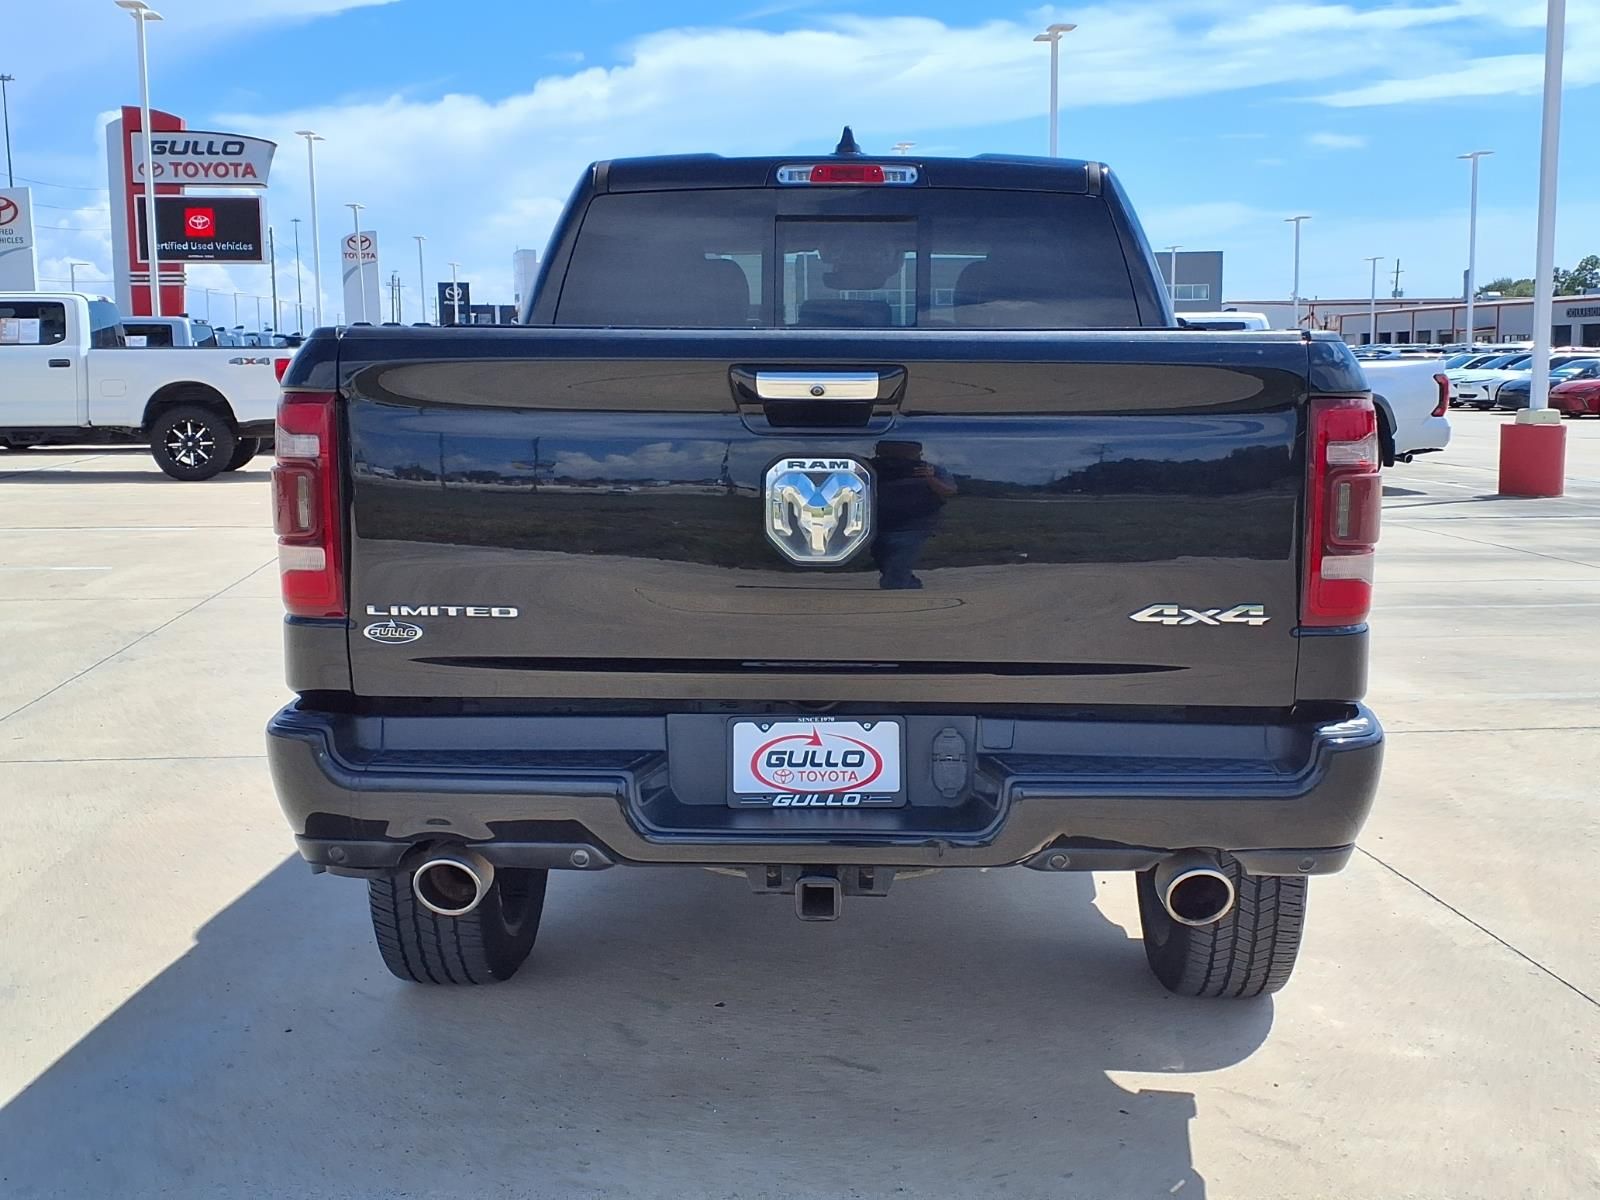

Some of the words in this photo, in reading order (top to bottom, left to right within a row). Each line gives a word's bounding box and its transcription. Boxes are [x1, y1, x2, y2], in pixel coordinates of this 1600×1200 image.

[152, 140, 245, 156] GULLO
[169, 161, 257, 178] TOYOTA
[156, 242, 188, 251] ertified
[190, 242, 214, 251] Used
[215, 242, 253, 251] Vehicles
[787, 460, 849, 470] RAM
[366, 605, 518, 618] LIMITED
[368, 626, 418, 638] GULLO
[765, 750, 866, 768] GULLO
[798, 770, 859, 783] TOYOTA
[772, 793, 861, 807] GULLO
